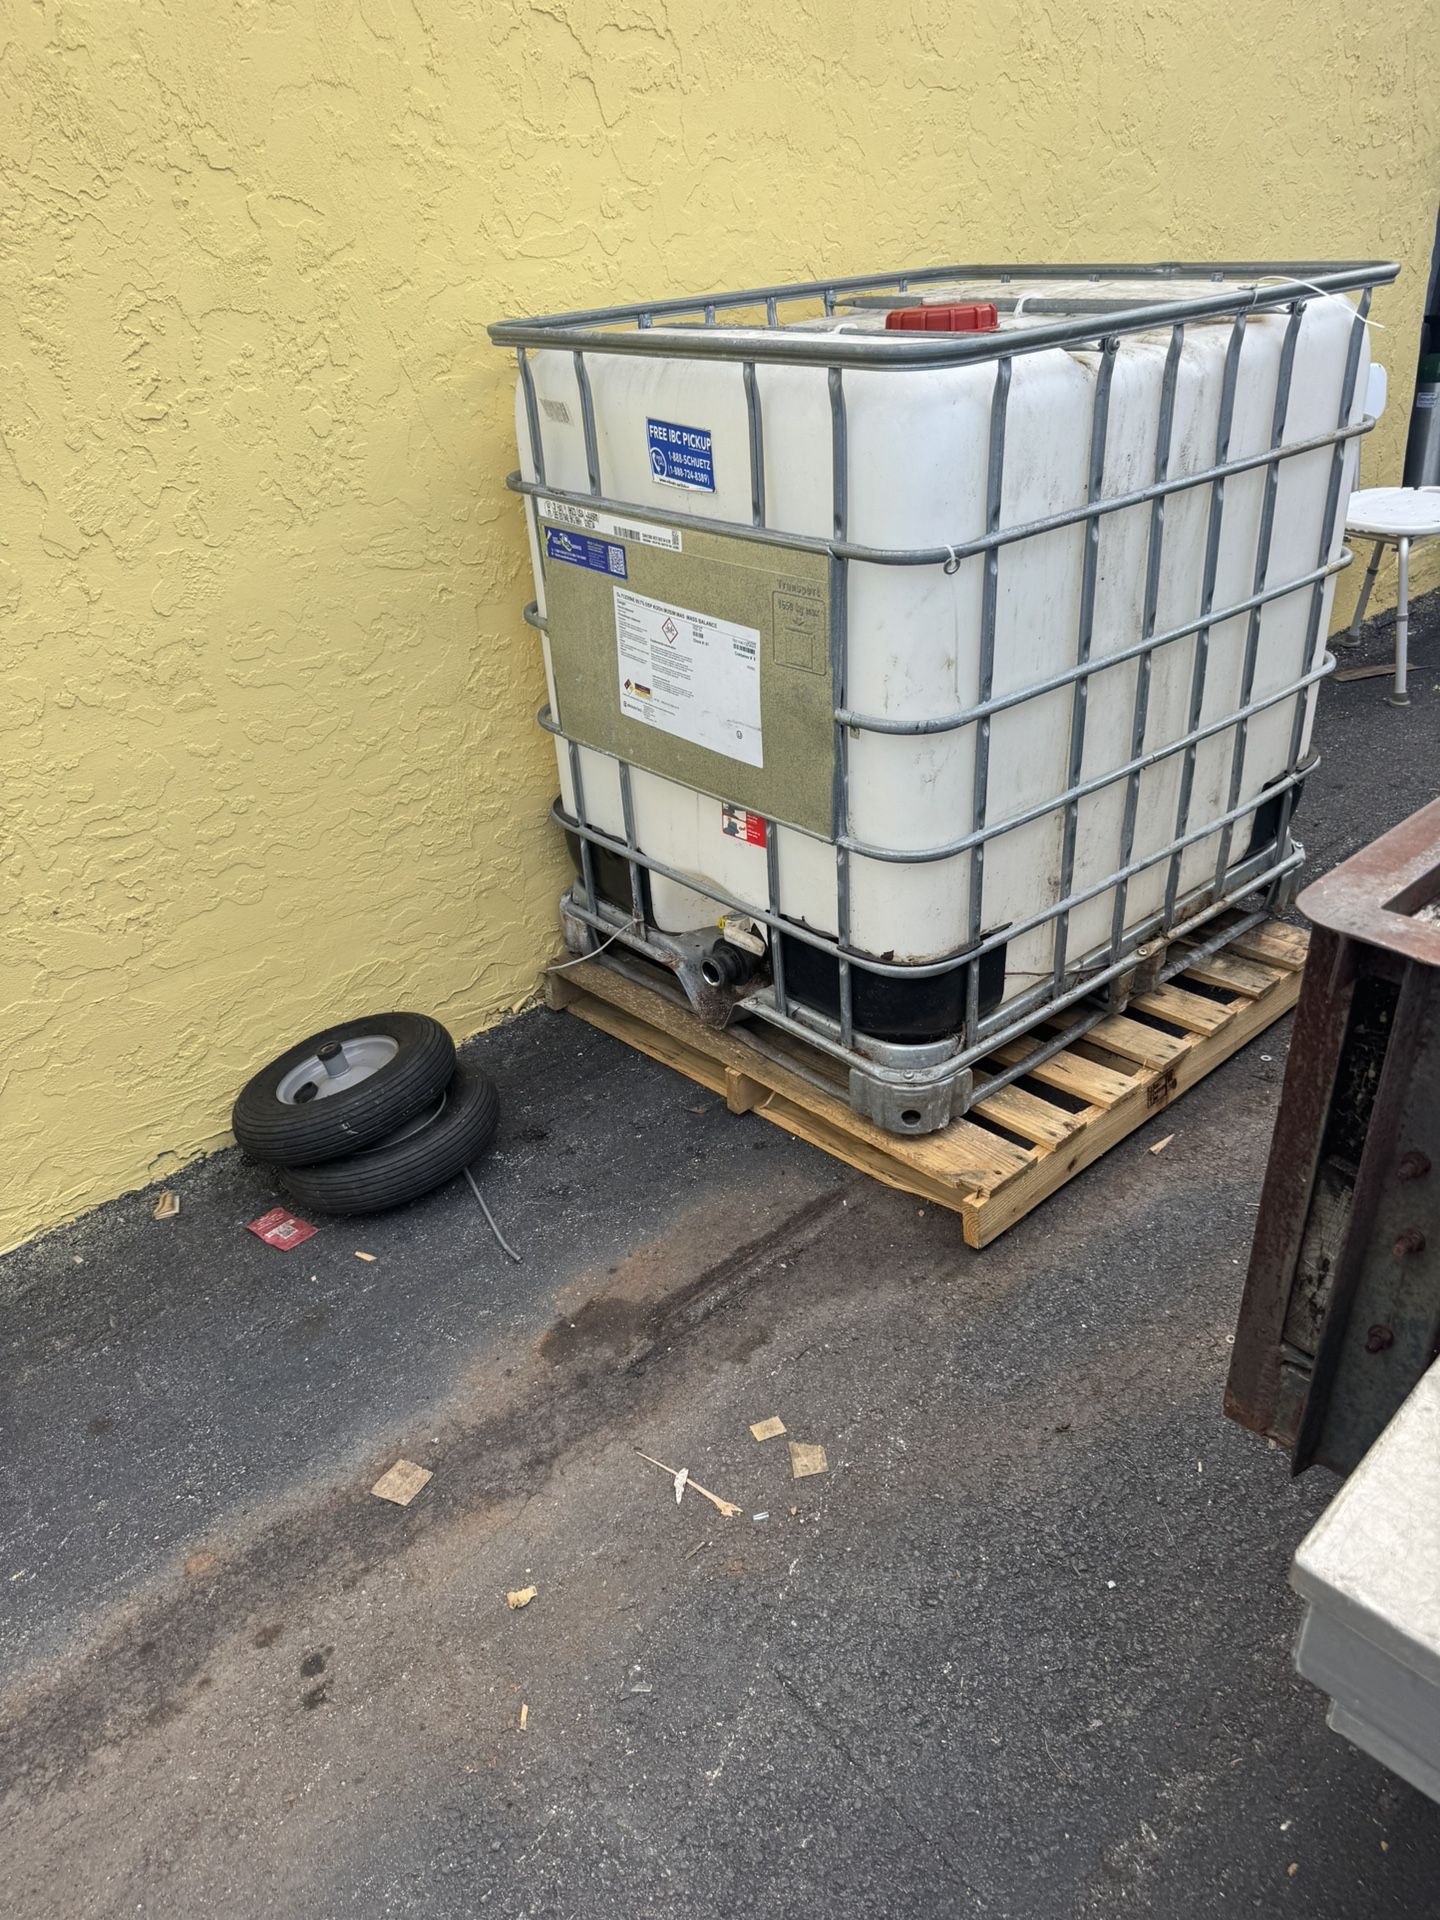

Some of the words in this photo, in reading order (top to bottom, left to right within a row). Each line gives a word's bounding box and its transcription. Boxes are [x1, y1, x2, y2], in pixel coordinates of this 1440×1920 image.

[649, 424, 668, 441] FREE
[668, 428, 682, 445] IBC
[682, 432, 711, 451] PICKUP
[668, 450, 711, 471] 1-888-SCHUETZ
[698, 618, 718, 629] BALANCE
